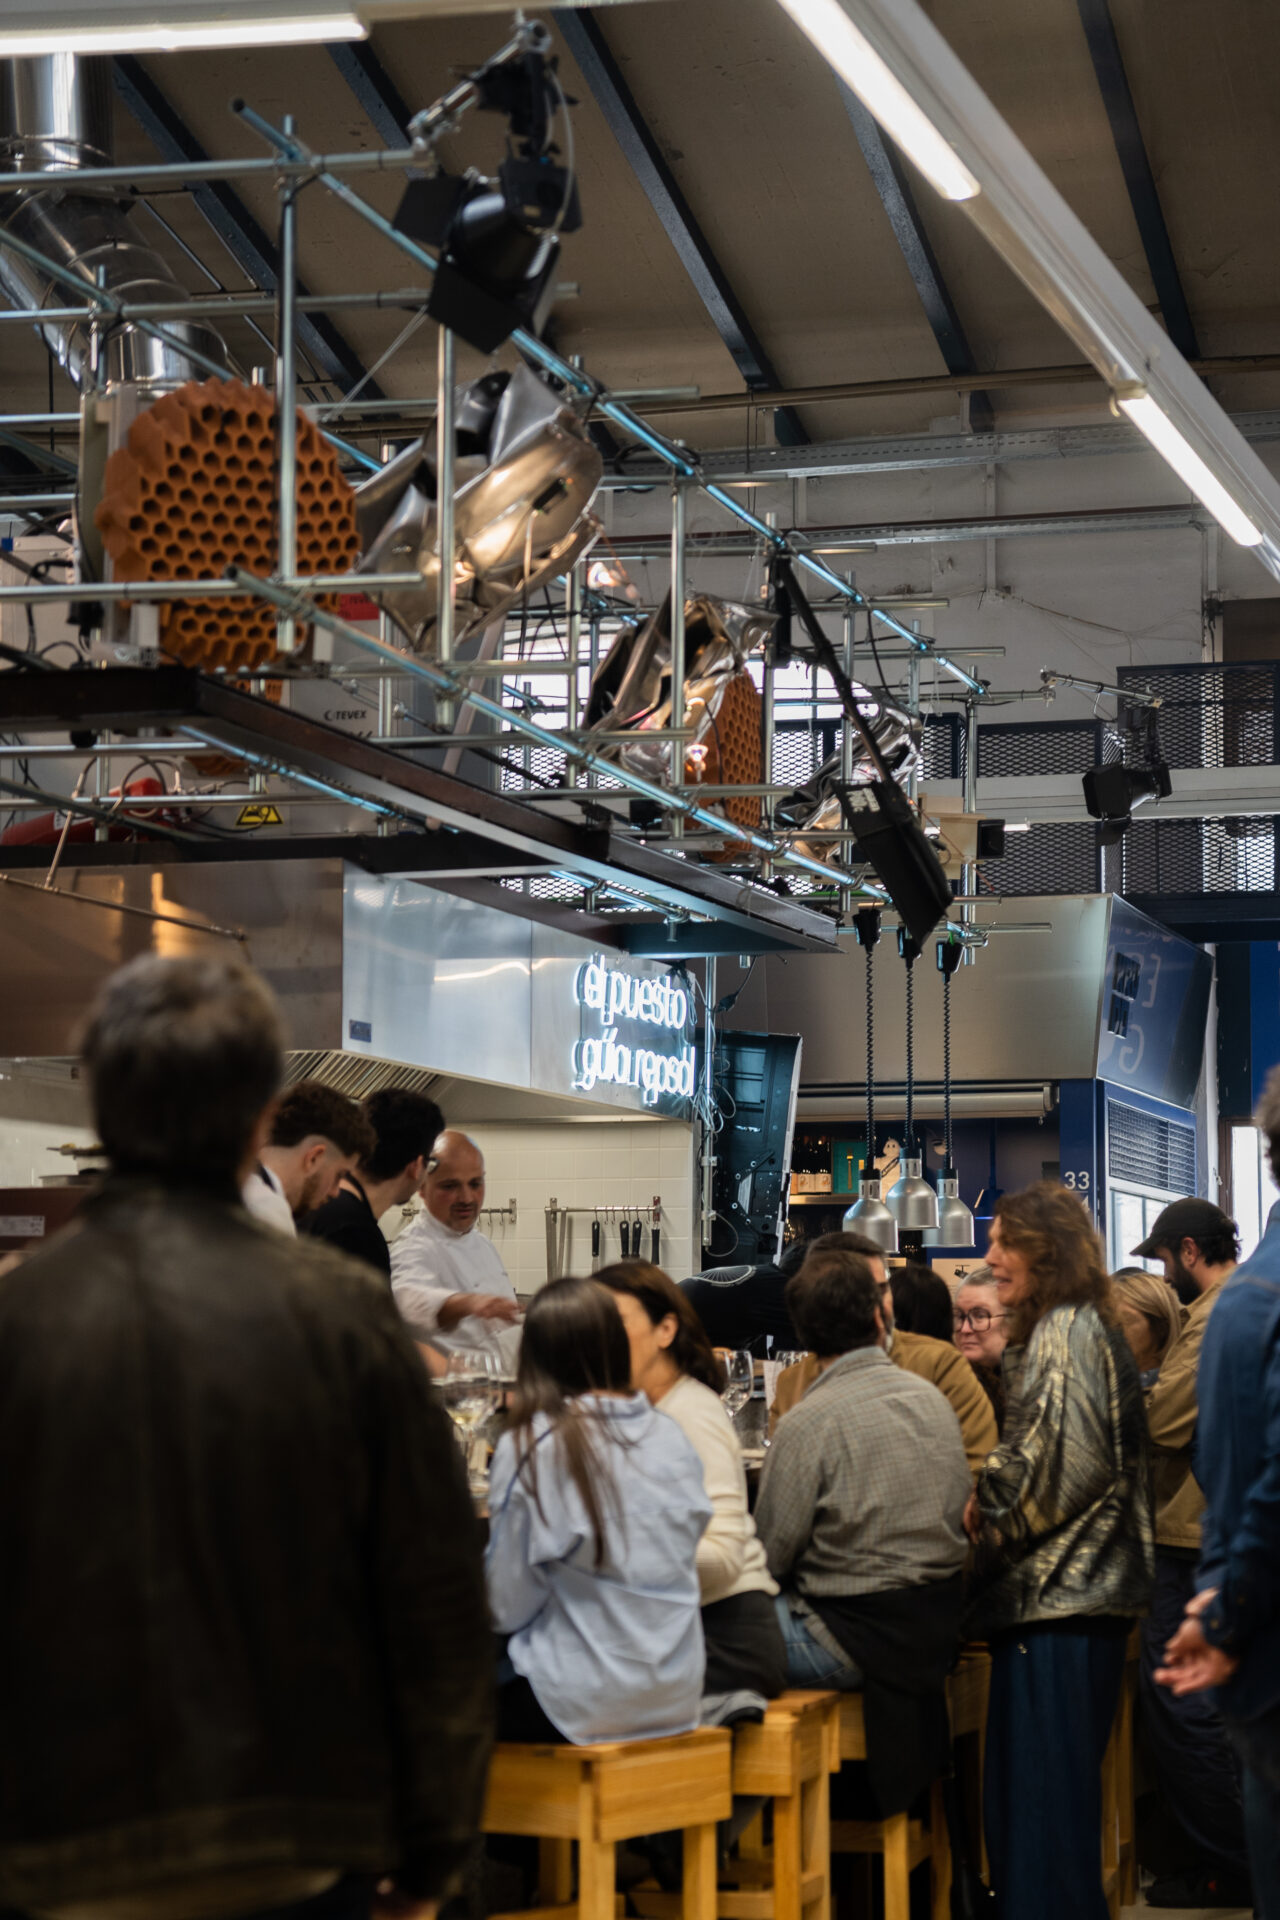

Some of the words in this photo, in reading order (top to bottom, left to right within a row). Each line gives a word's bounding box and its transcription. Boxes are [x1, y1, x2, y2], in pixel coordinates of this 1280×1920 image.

[575, 954, 606, 1009] el
[603, 969, 687, 1030] puesto
[632, 1045, 695, 1104] repsol
[1064, 1171, 1090, 1190] 33
